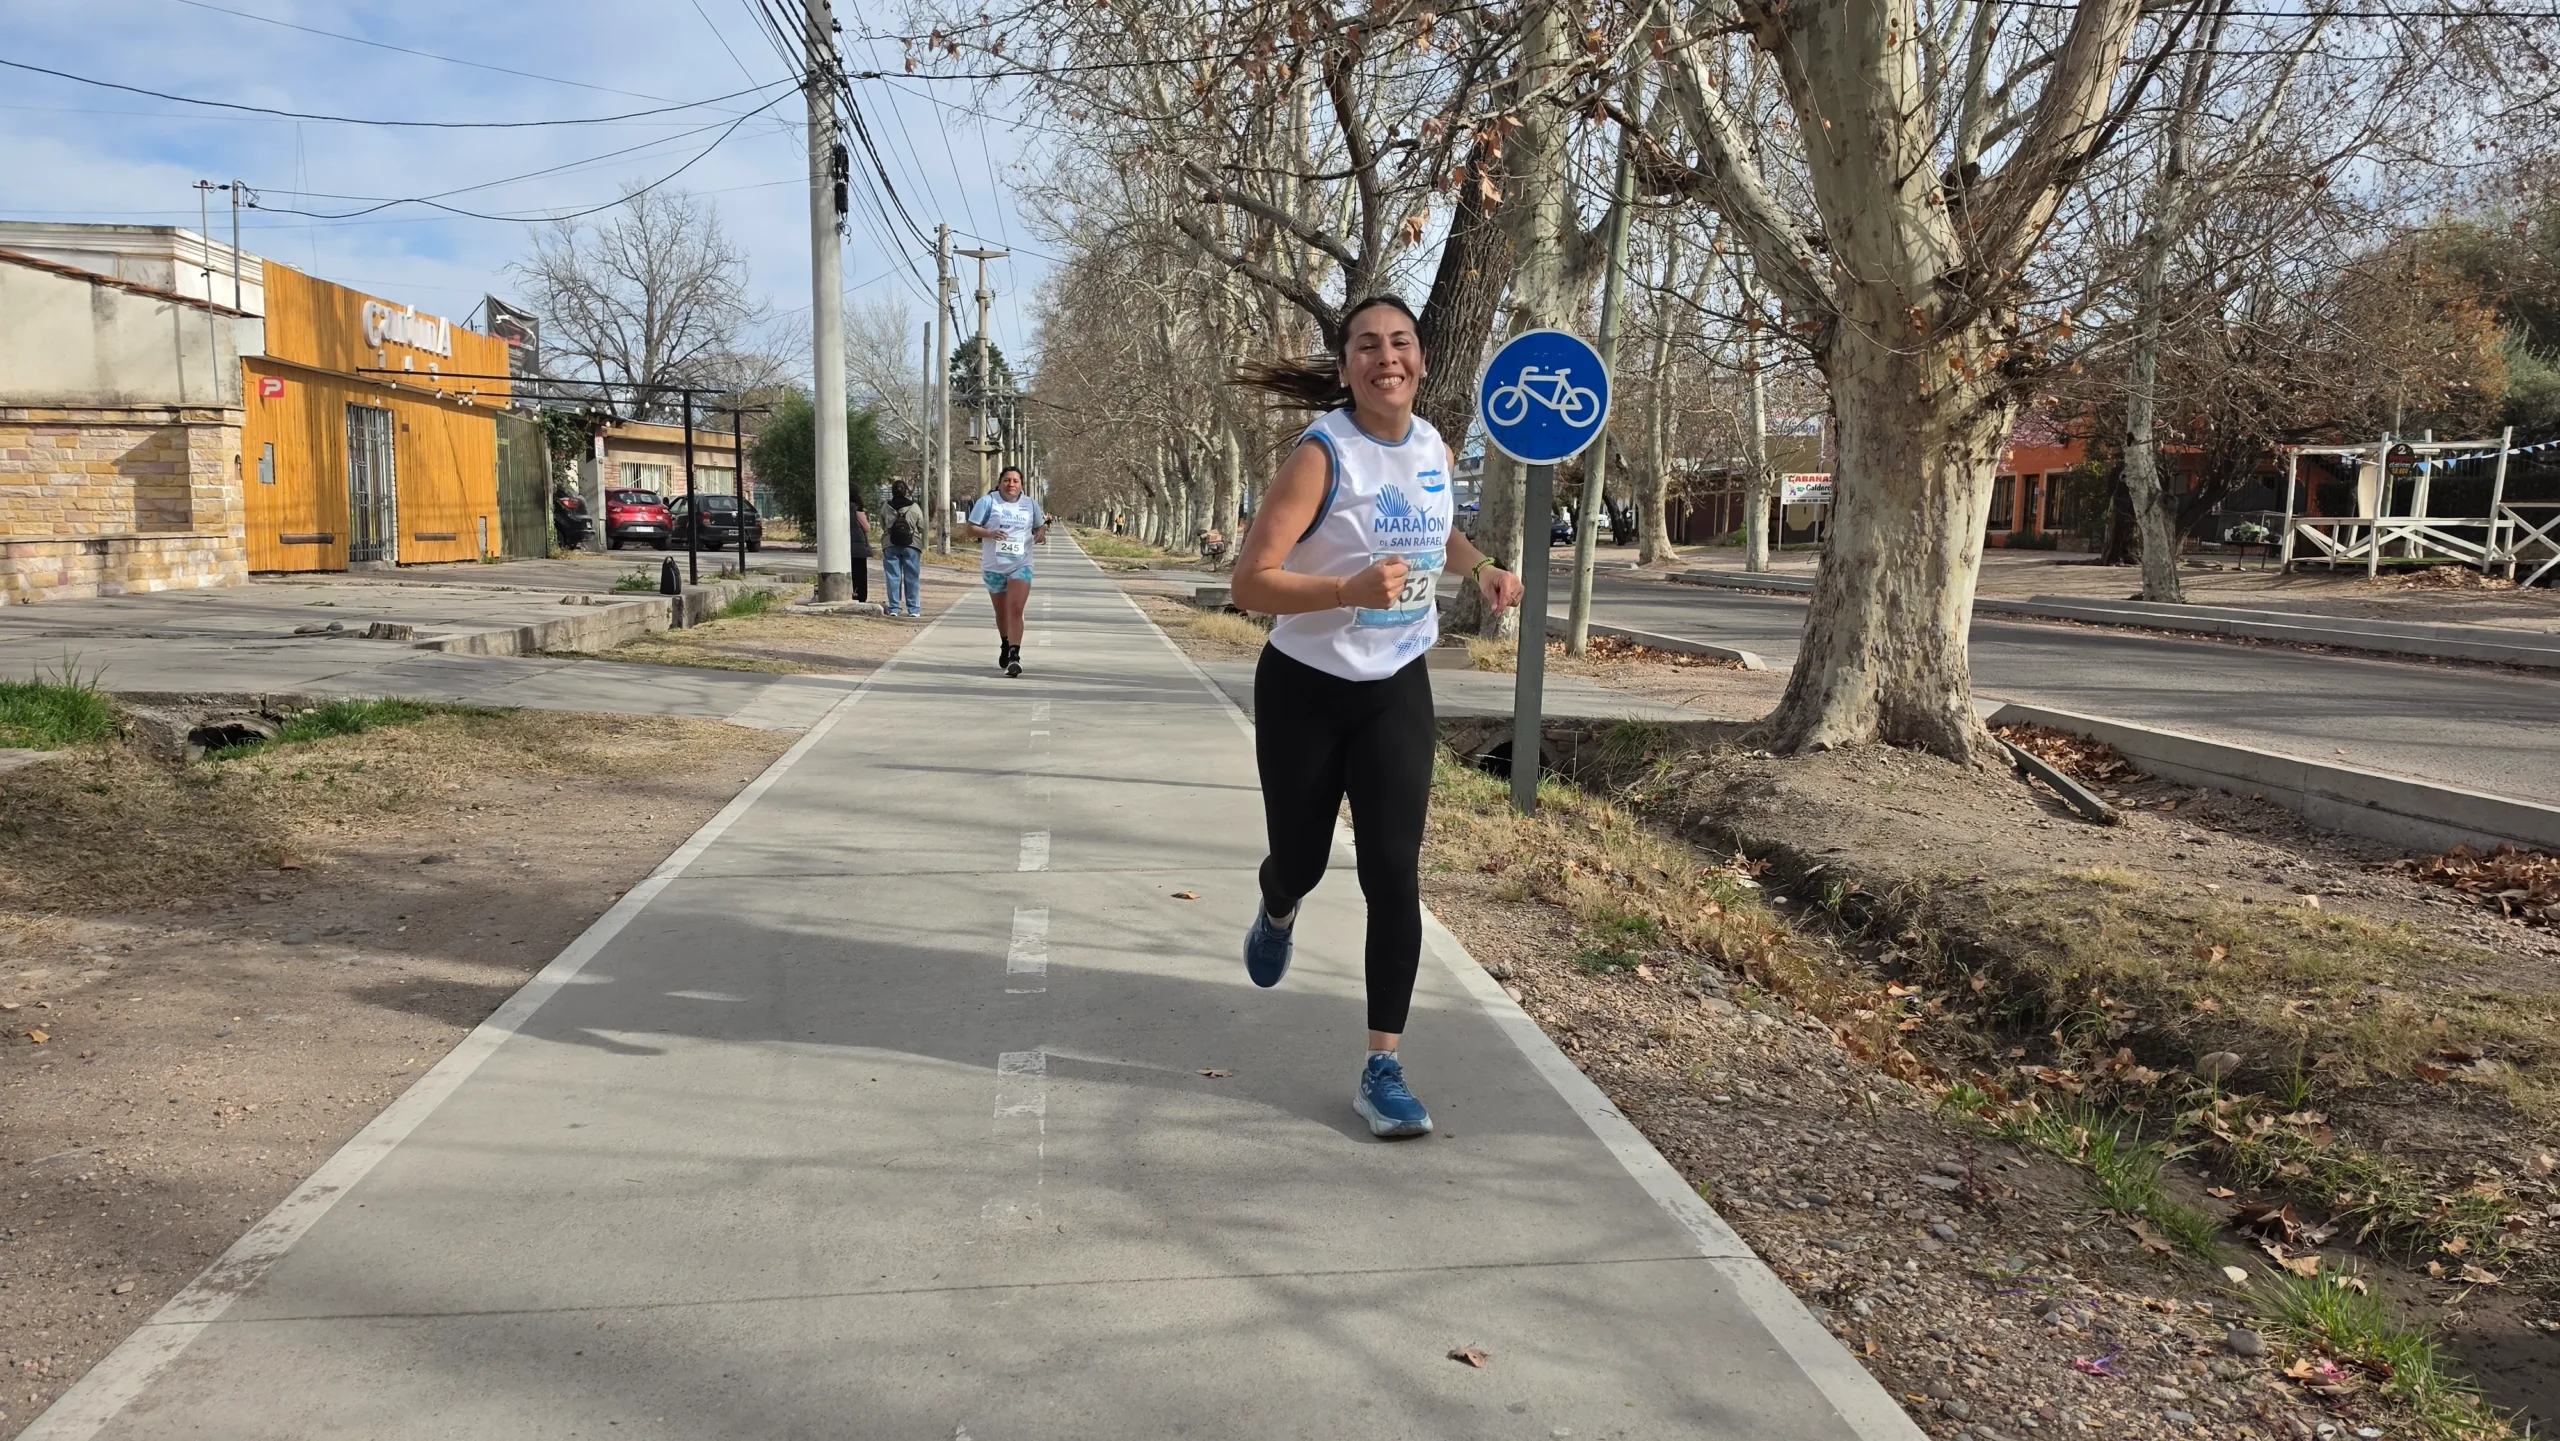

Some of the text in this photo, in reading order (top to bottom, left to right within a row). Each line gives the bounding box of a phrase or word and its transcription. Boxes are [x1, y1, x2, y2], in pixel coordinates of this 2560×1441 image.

[1390, 537, 1412, 547] SAN
[1413, 536, 1442, 547] RAFAEL
[1001, 543, 1019, 552] 245
